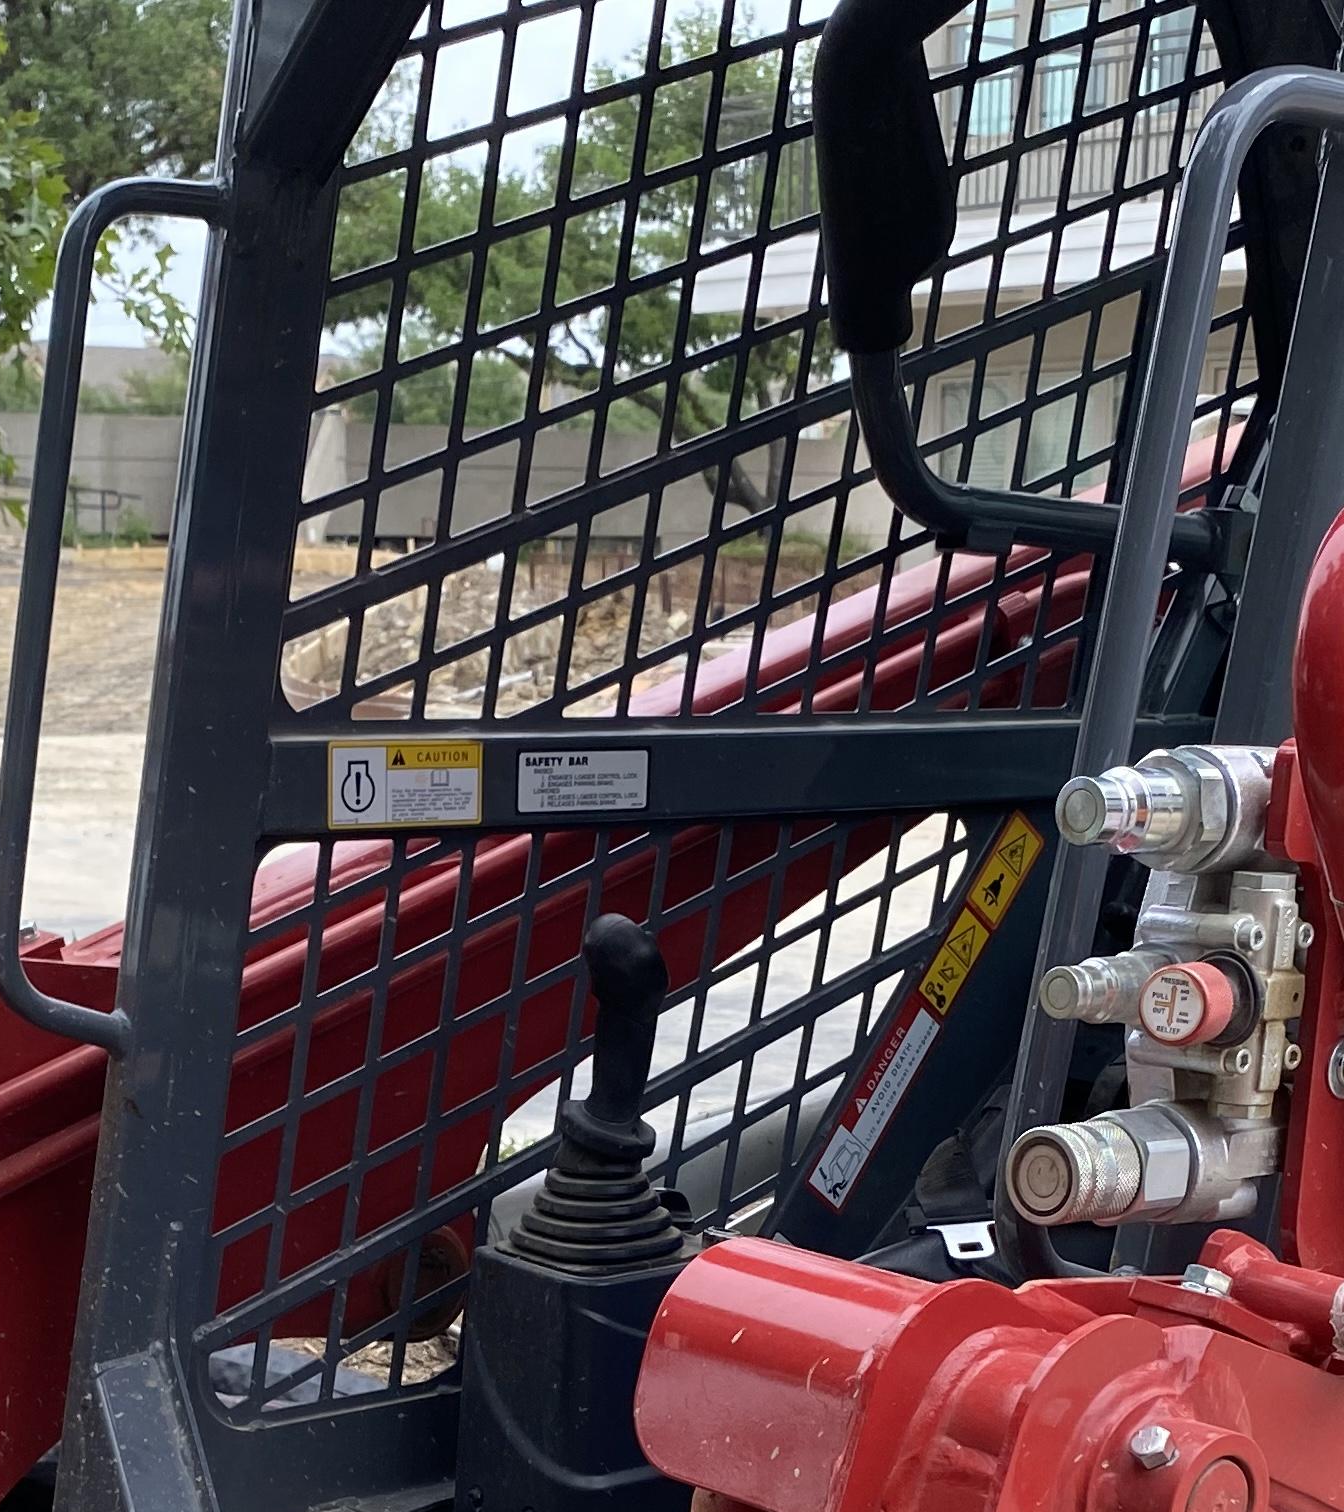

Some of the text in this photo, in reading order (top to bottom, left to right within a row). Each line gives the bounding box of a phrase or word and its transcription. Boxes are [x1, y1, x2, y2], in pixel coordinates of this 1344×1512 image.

[417, 751, 468, 763] CAUTION
[525, 756, 589, 767] SAFETY BAR
[1160, 976, 1189, 987] PRESSURE
[1152, 991, 1169, 1000] PULL
[1156, 1025, 1180, 1035] RELIEF
[866, 1027, 906, 1091] DANGER
[870, 1042, 912, 1114] AVOID DEATH
